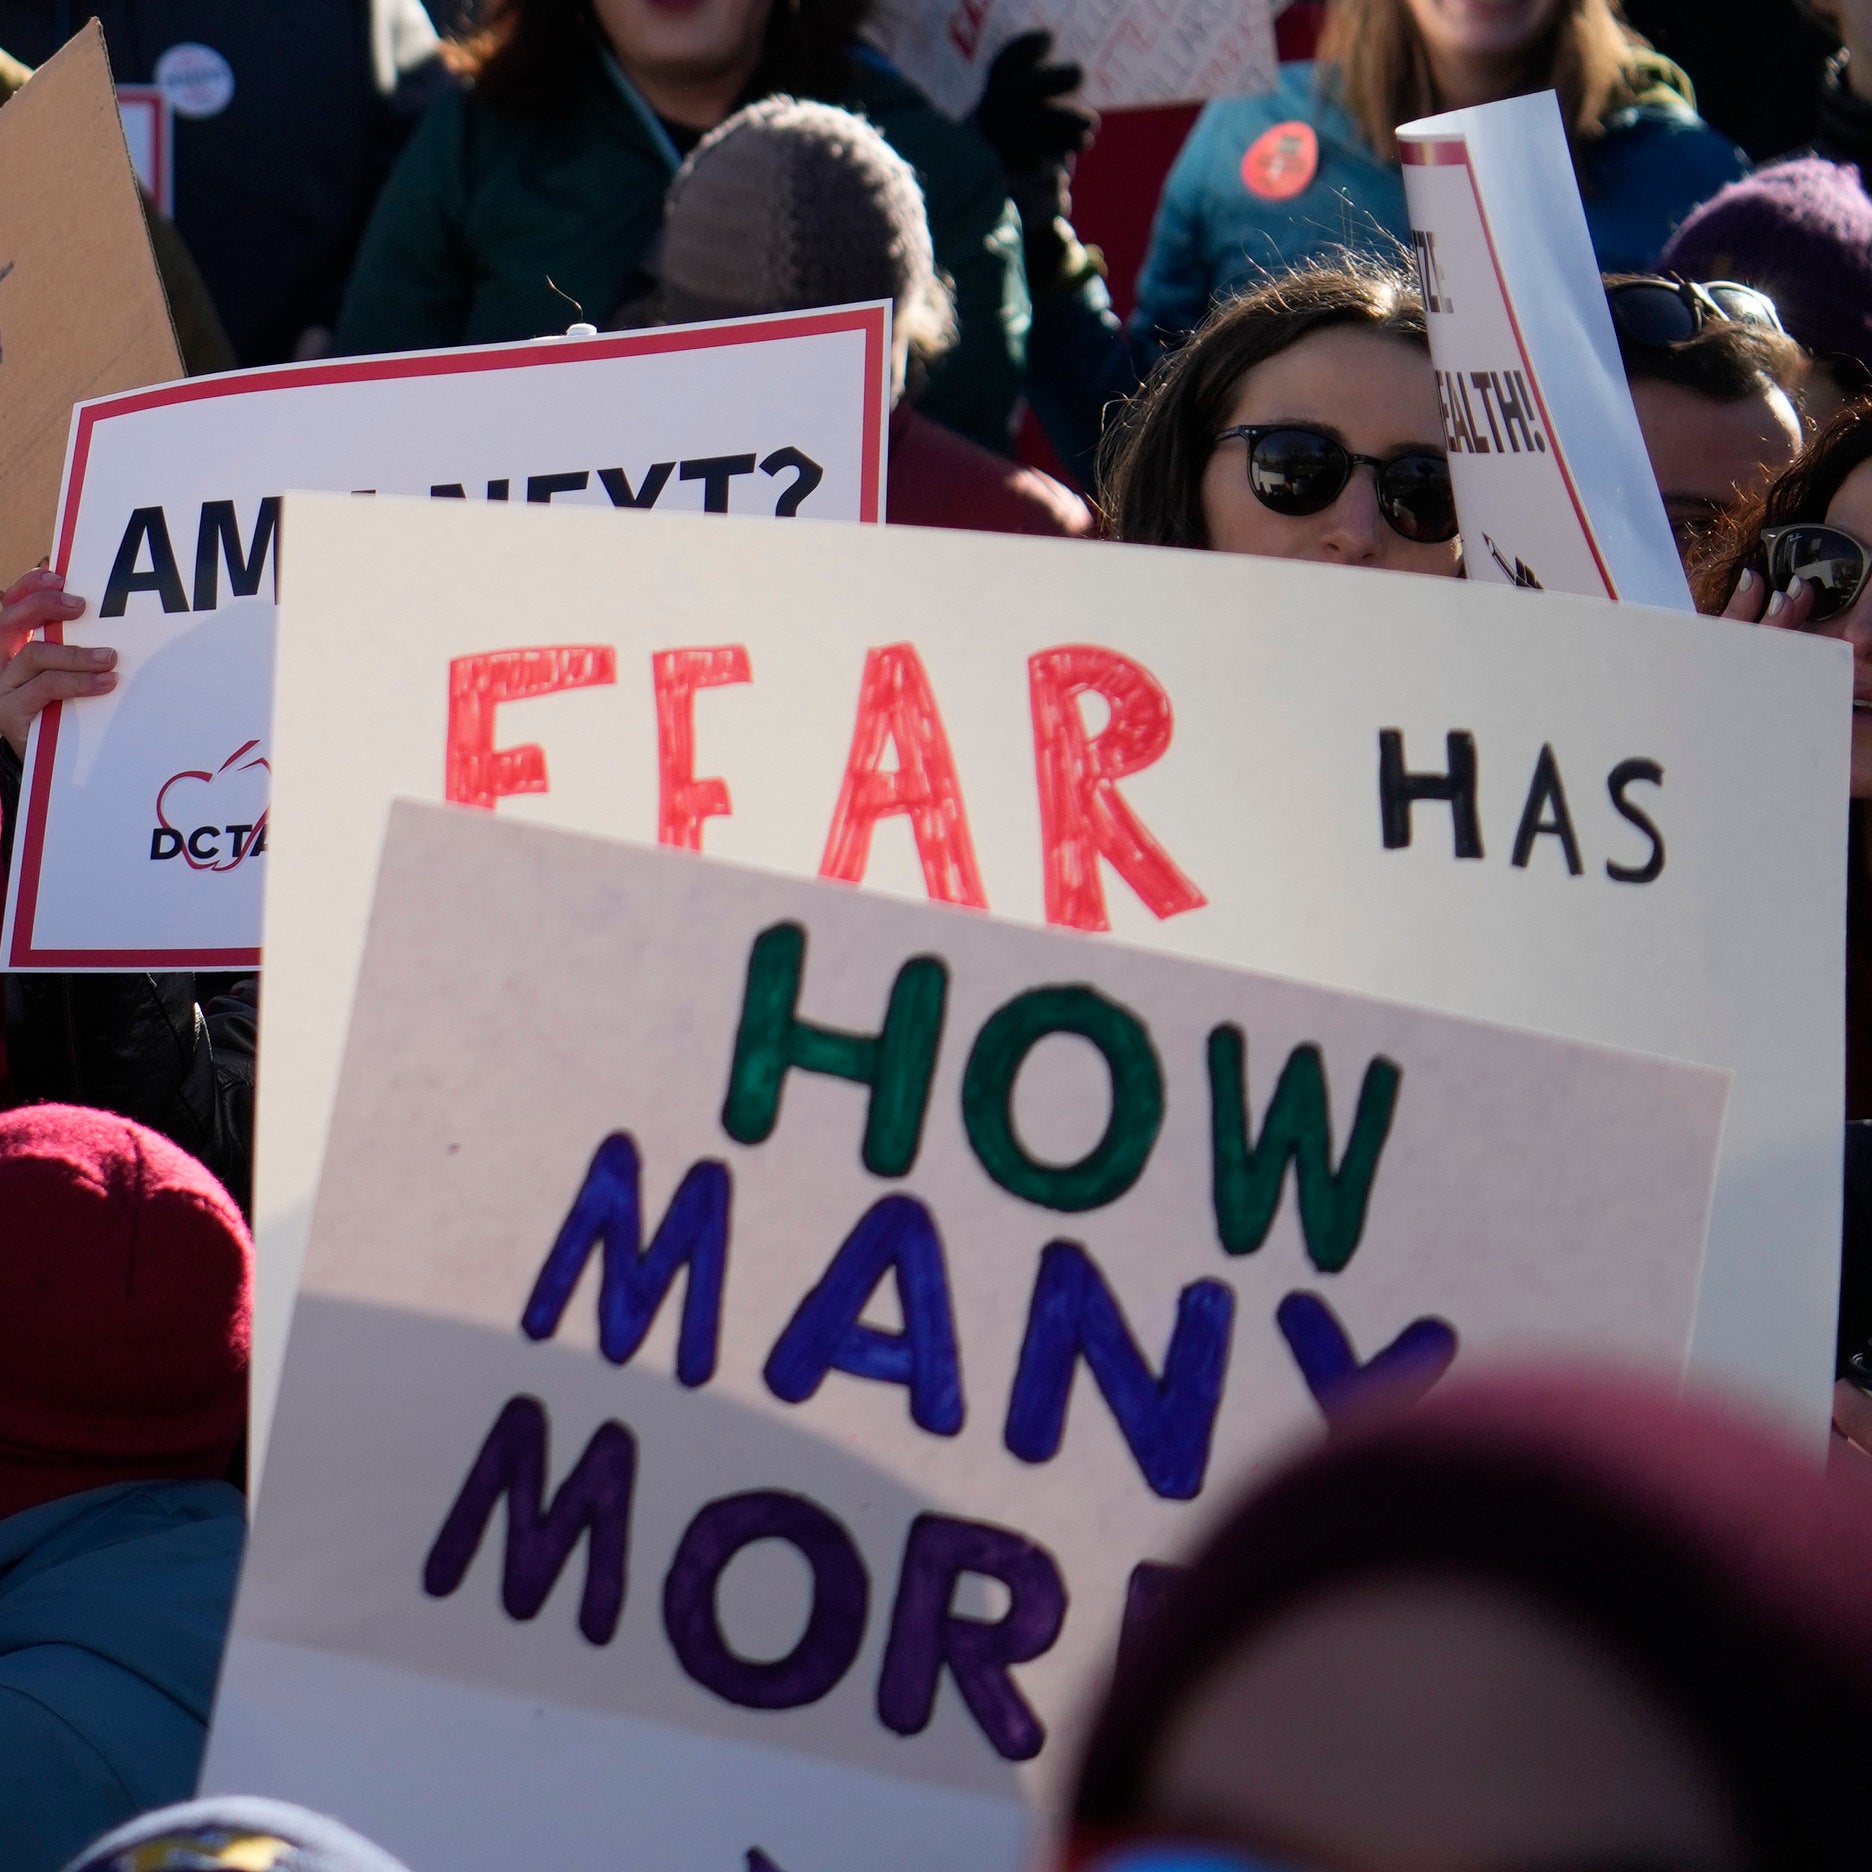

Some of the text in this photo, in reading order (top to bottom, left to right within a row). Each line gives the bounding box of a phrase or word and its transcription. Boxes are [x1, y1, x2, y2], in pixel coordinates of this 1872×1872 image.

[99, 495, 281, 619] AM
[1436, 370, 1545, 453] EALTH!
[443, 640, 1666, 932] FEAR HAS
[721, 920, 1402, 1276] HOW
[519, 1129, 1459, 1503] MANY
[423, 1393, 1186, 1763] MOR
